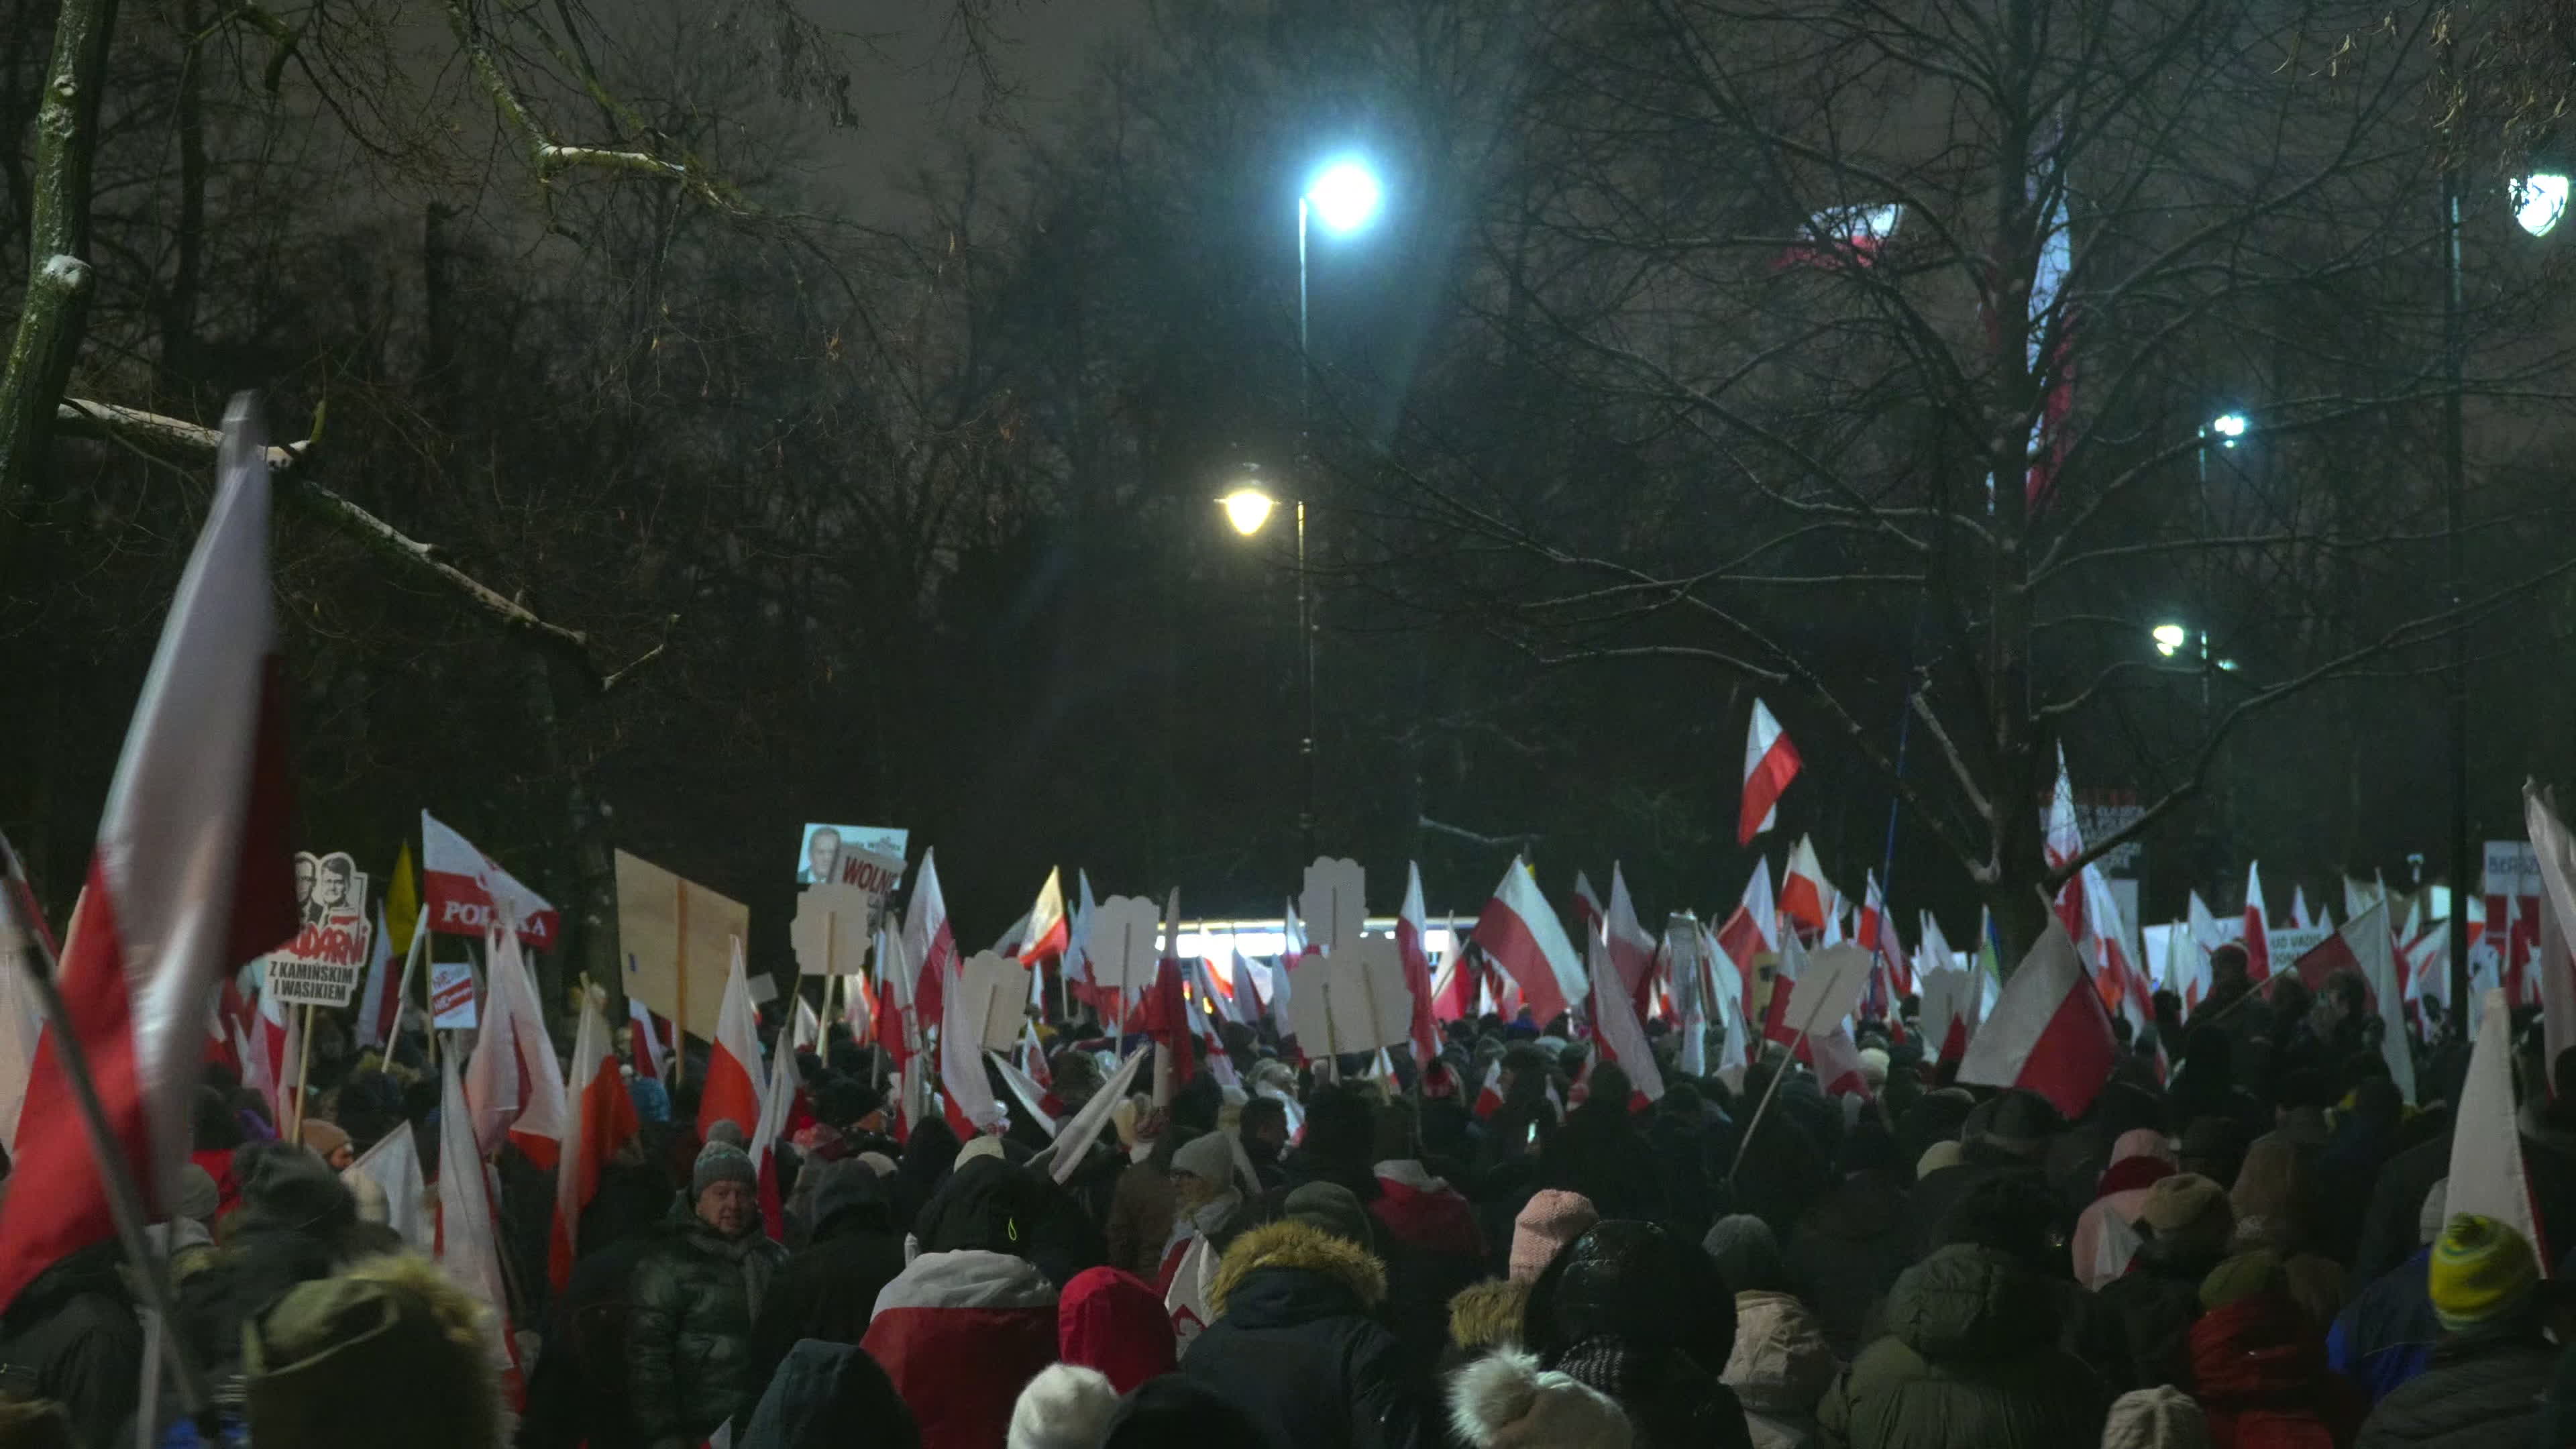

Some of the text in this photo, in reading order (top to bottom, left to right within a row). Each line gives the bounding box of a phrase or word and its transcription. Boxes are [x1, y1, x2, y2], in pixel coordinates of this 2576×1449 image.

[441, 900, 547, 936] POLKA
[269, 961, 354, 985] Z KAMIŃSKIM
[274, 979, 279, 995] I
